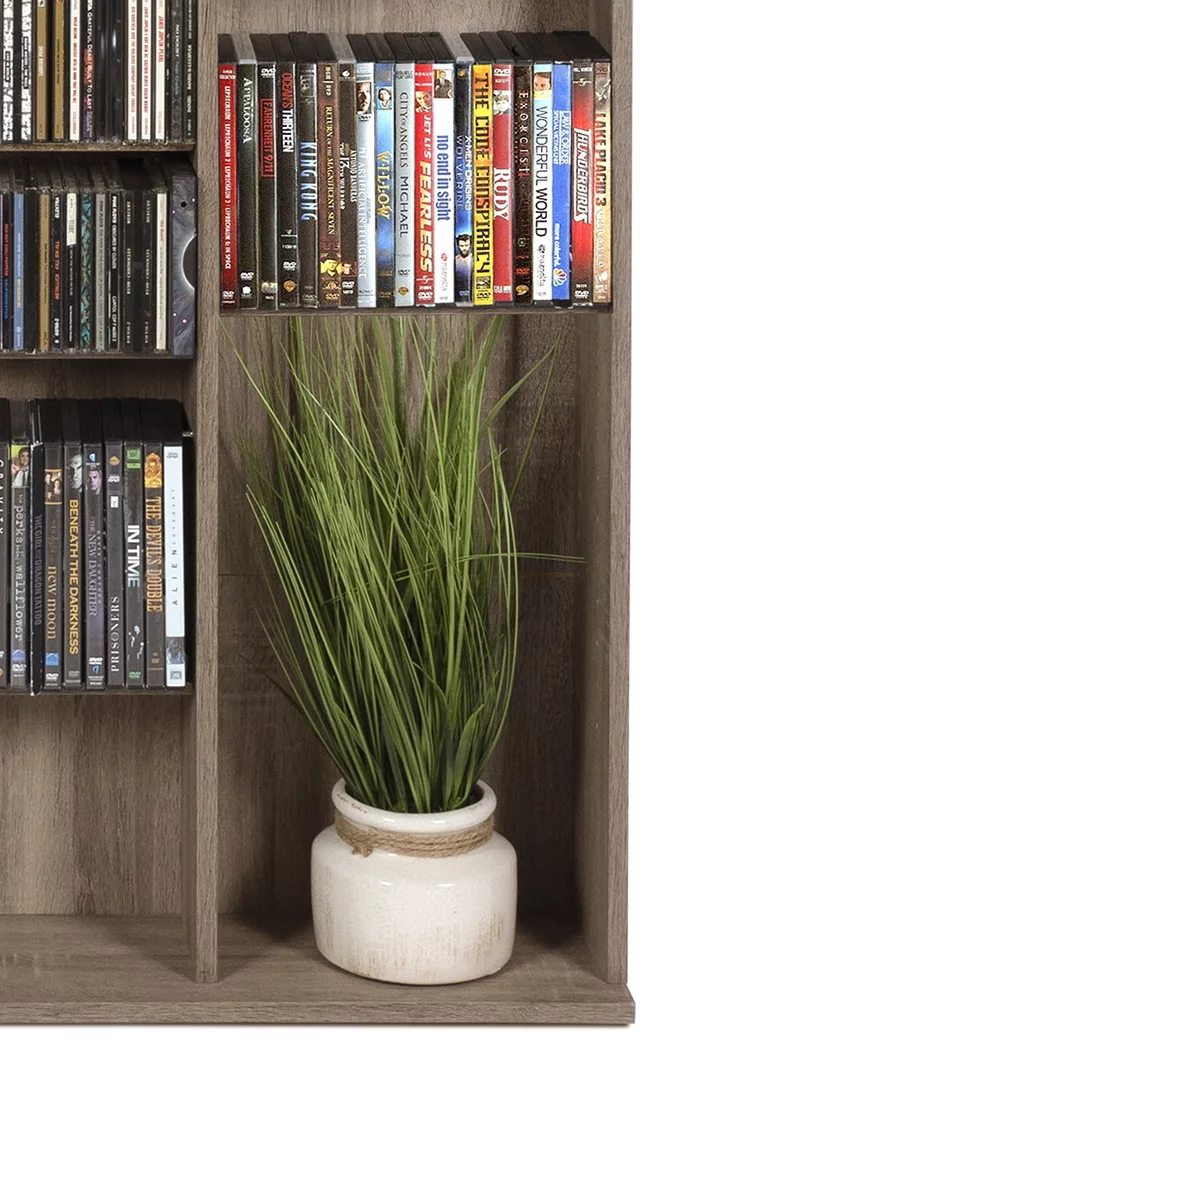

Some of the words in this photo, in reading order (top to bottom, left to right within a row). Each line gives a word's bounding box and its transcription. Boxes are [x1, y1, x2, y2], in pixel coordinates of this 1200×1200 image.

[242, 78, 253, 143] APPALOOSA
[283, 73, 293, 108] OCEAN'S
[400, 92, 408, 118] CITY
[475, 73, 490, 109] THE
[263, 102, 273, 153] FAHRENHEIT
[283, 109, 293, 152] THIRTEEN
[326, 106, 334, 136] RETURN
[475, 116, 490, 159] CODE
[301, 142, 316, 176] KING
[400, 126, 408, 167] ANGELS
[438, 135, 449, 150] no
[536, 107, 548, 185] WONDERFUL
[264, 155, 273, 172] 9/11
[327, 158, 335, 208] MAGNIFICENT
[438, 153, 450, 176] end
[573, 128, 591, 224] THUNDERBIRDS
[301, 183, 317, 220] KONG
[400, 176, 409, 238] MICHAEL
[435, 188, 450, 221] sight
[494, 168, 509, 220] RUDY
[536, 188, 548, 237] WORLD
[420, 161, 432, 271] FEARLESS
[476, 166, 490, 274] CONSPIRACY
[14, 506, 25, 543] perks
[70, 499, 78, 557] BENEATH
[146, 497, 161, 520] THE
[128, 525, 140, 543] IN
[147, 525, 162, 565] DEVIL'S
[48, 566, 56, 595] new
[70, 560, 78, 584] THE
[128, 546, 140, 587] TIME
[15, 566, 25, 641] wallflower
[147, 569, 162, 612] DOUBLE
[48, 599, 56, 639] moon
[70, 588, 78, 654] DARKNESS
